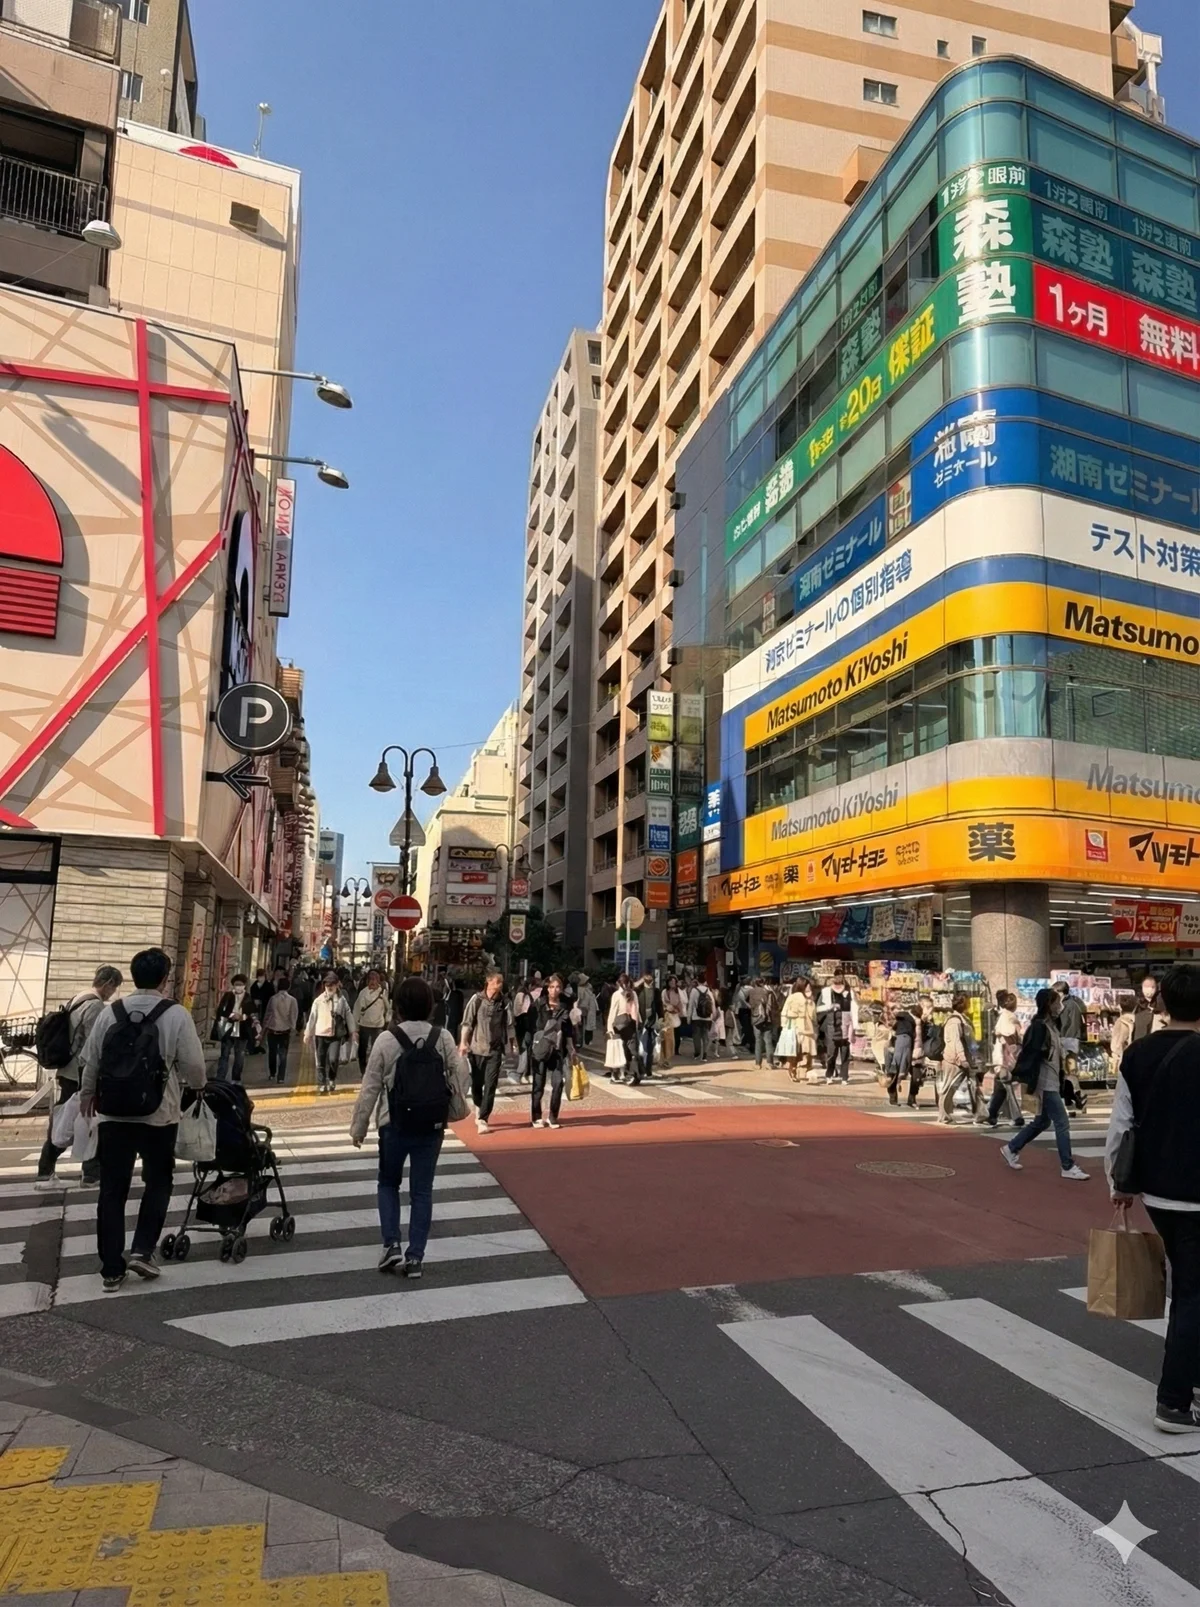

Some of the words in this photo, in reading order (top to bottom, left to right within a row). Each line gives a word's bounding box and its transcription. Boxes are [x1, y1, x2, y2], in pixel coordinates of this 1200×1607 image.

[1042, 213, 1114, 280] 森塾
[1132, 250, 1197, 313] 森塾
[1139, 313, 1200, 370] 無料
[1091, 522, 1200, 577] テスト対策
[766, 677, 842, 733] Matsumoto
[845, 632, 908, 691] KiYoshi
[239, 696, 273, 737] P
[771, 806, 840, 841] Matsumoto
[841, 782, 899, 821] KiYoshi
[783, 864, 799, 884] 薬
[821, 843, 888, 883] マツモトキヨシ
[968, 821, 1017, 862] 薬
